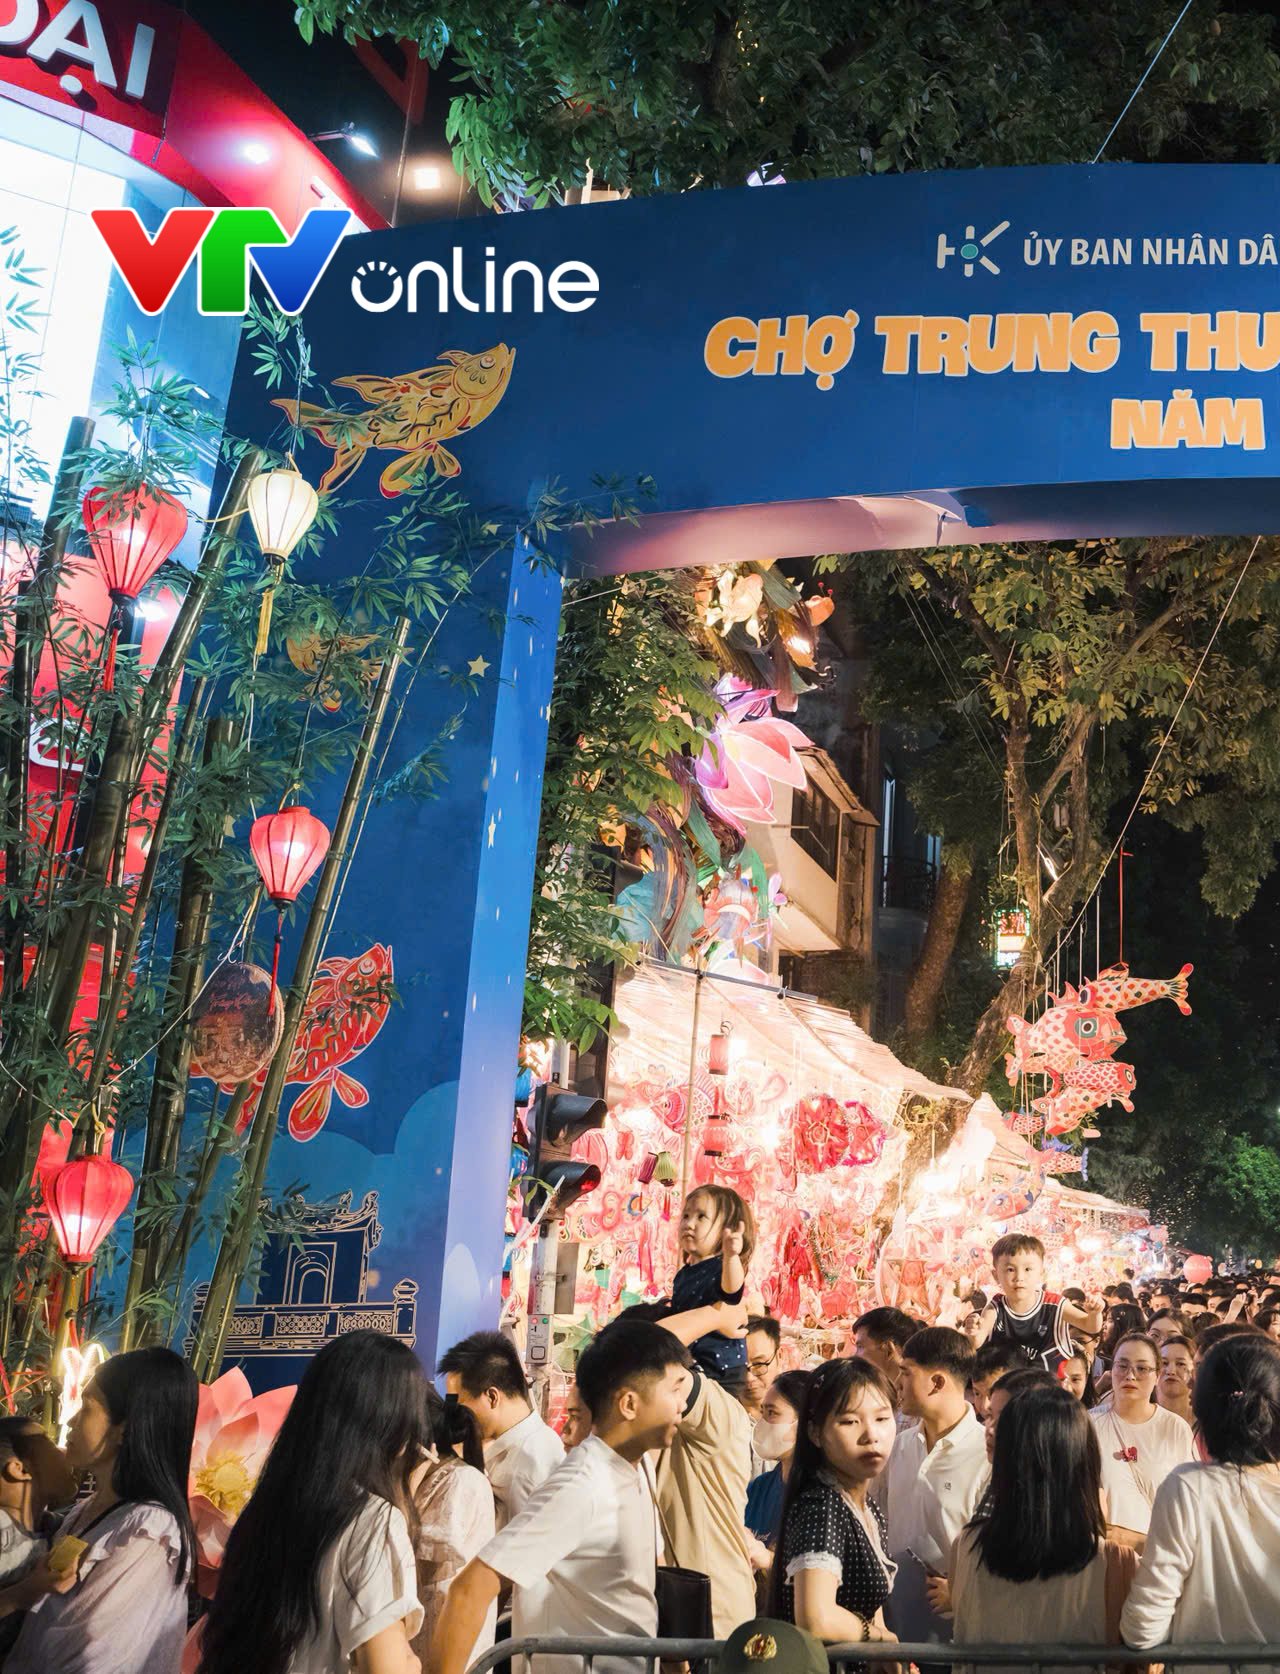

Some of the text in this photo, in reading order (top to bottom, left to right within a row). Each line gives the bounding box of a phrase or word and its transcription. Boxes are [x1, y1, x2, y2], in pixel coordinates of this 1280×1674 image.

[1023, 231, 1063, 266] ỦY
[1070, 238, 1133, 266] BAN
[1143, 233, 1229, 266] NHÂN
[704, 309, 860, 391] CHỢ
[874, 311, 1121, 376] TRUNG
[1110, 388, 1266, 451] NĂM
